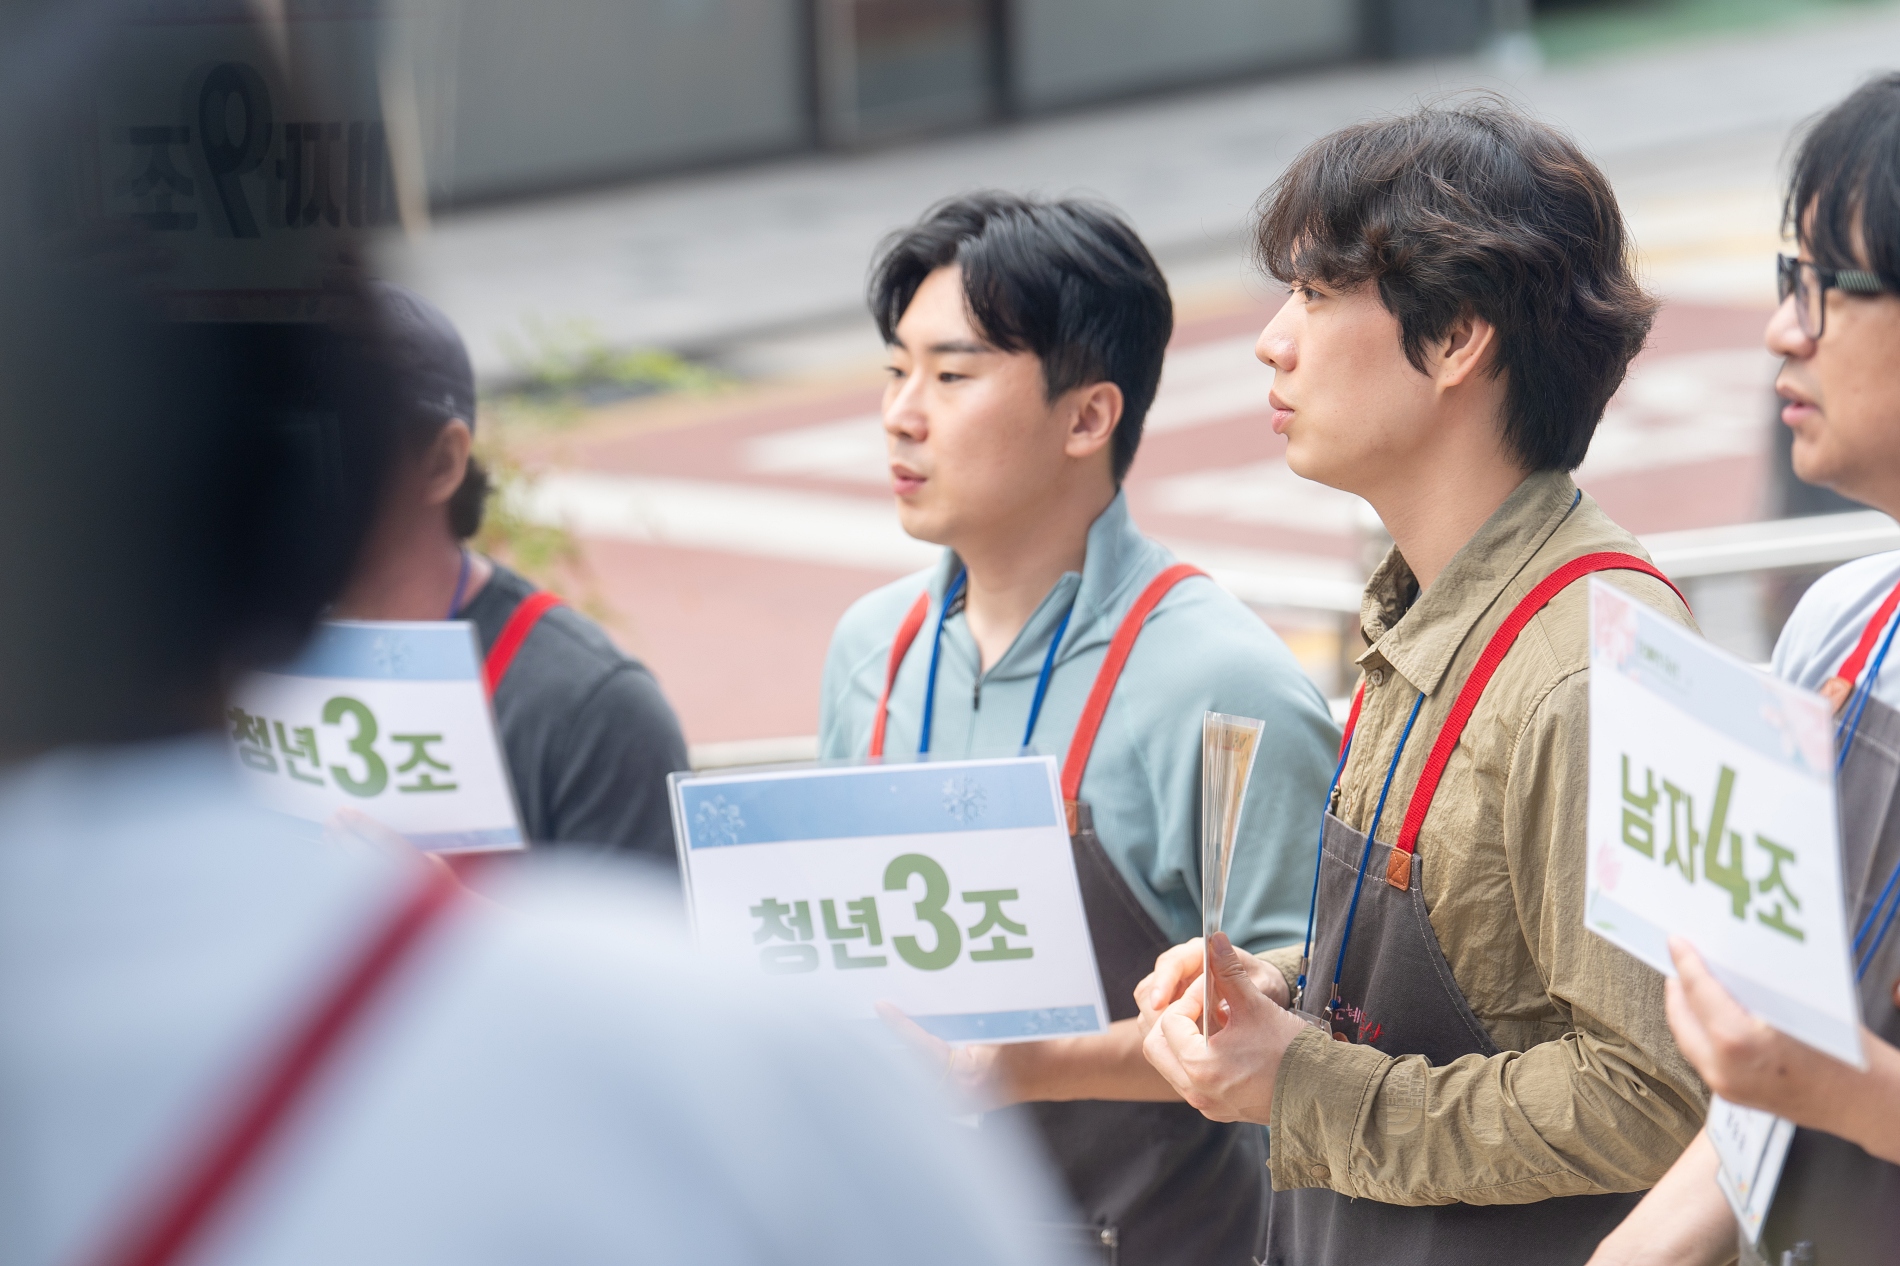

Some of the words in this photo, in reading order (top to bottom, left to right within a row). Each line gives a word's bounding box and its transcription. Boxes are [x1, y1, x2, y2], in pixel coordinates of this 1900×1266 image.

[227, 695, 459, 798] 청년3조
[1620, 751, 1806, 944] 남자4조
[748, 852, 1035, 975] 청년3조
[1397, 1065, 1413, 1107] ORTH
[1410, 1076, 1425, 1107] THE
